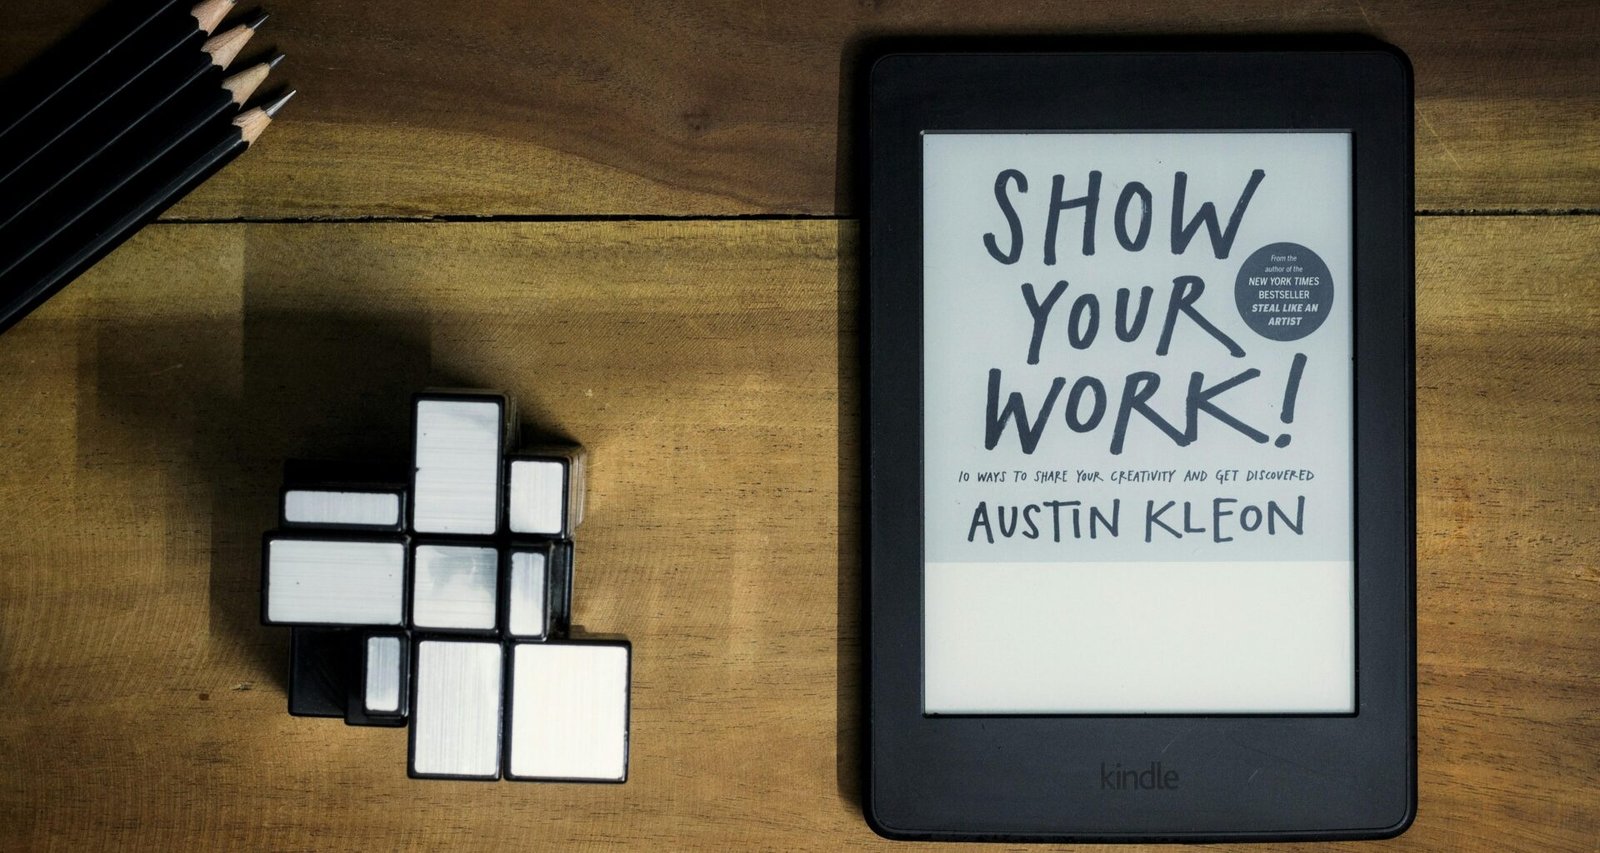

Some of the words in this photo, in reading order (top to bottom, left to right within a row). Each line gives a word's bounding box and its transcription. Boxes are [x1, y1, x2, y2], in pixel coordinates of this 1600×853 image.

[982, 168, 1266, 265] SHOW
[1270, 254, 1286, 262] From
[1287, 254, 1297, 262] the
[1248, 277, 1268, 286] NEW
[1270, 277, 1292, 286] YORK
[1294, 276, 1320, 286] TIMES
[1258, 290, 1310, 299] BESTSELLER
[1251, 304, 1280, 313] STEAL
[1282, 304, 1303, 313] LIKE
[1304, 304, 1319, 313] AN
[1020, 275, 1246, 365] YOUR
[1268, 317, 1302, 326] ARTIST
[983, 352, 1307, 455] WORK!
[977, 470, 1007, 483] WAYS
[1013, 470, 1028, 482] TO
[1033, 470, 1068, 483] SHARE
[1076, 470, 1104, 483] YOUR
[1110, 470, 1177, 484] CREATIVITY
[1183, 470, 1208, 482] AND
[1215, 470, 1239, 484] GET
[1246, 470, 1315, 482] DISCOVERED
[967, 498, 1120, 544] AUSTIN
[1144, 496, 1306, 543] KLEON
[1101, 761, 1180, 790] kindle
